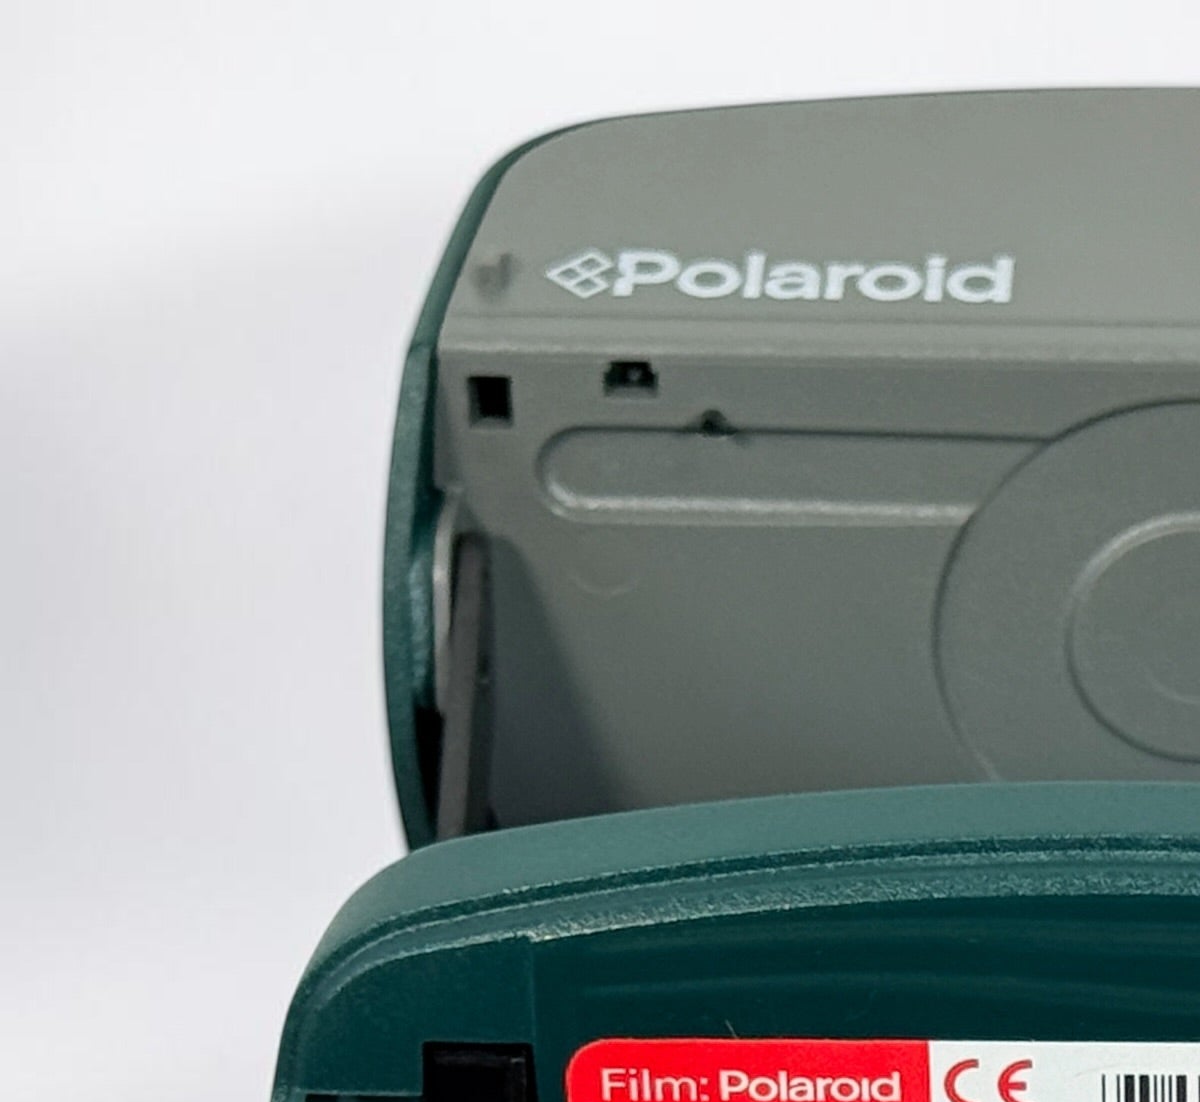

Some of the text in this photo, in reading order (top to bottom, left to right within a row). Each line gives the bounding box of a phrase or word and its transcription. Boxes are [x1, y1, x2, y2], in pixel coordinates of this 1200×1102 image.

[613, 249, 1016, 303] Polaroid
[600, 1067, 901, 1102] Film: Polaroid
